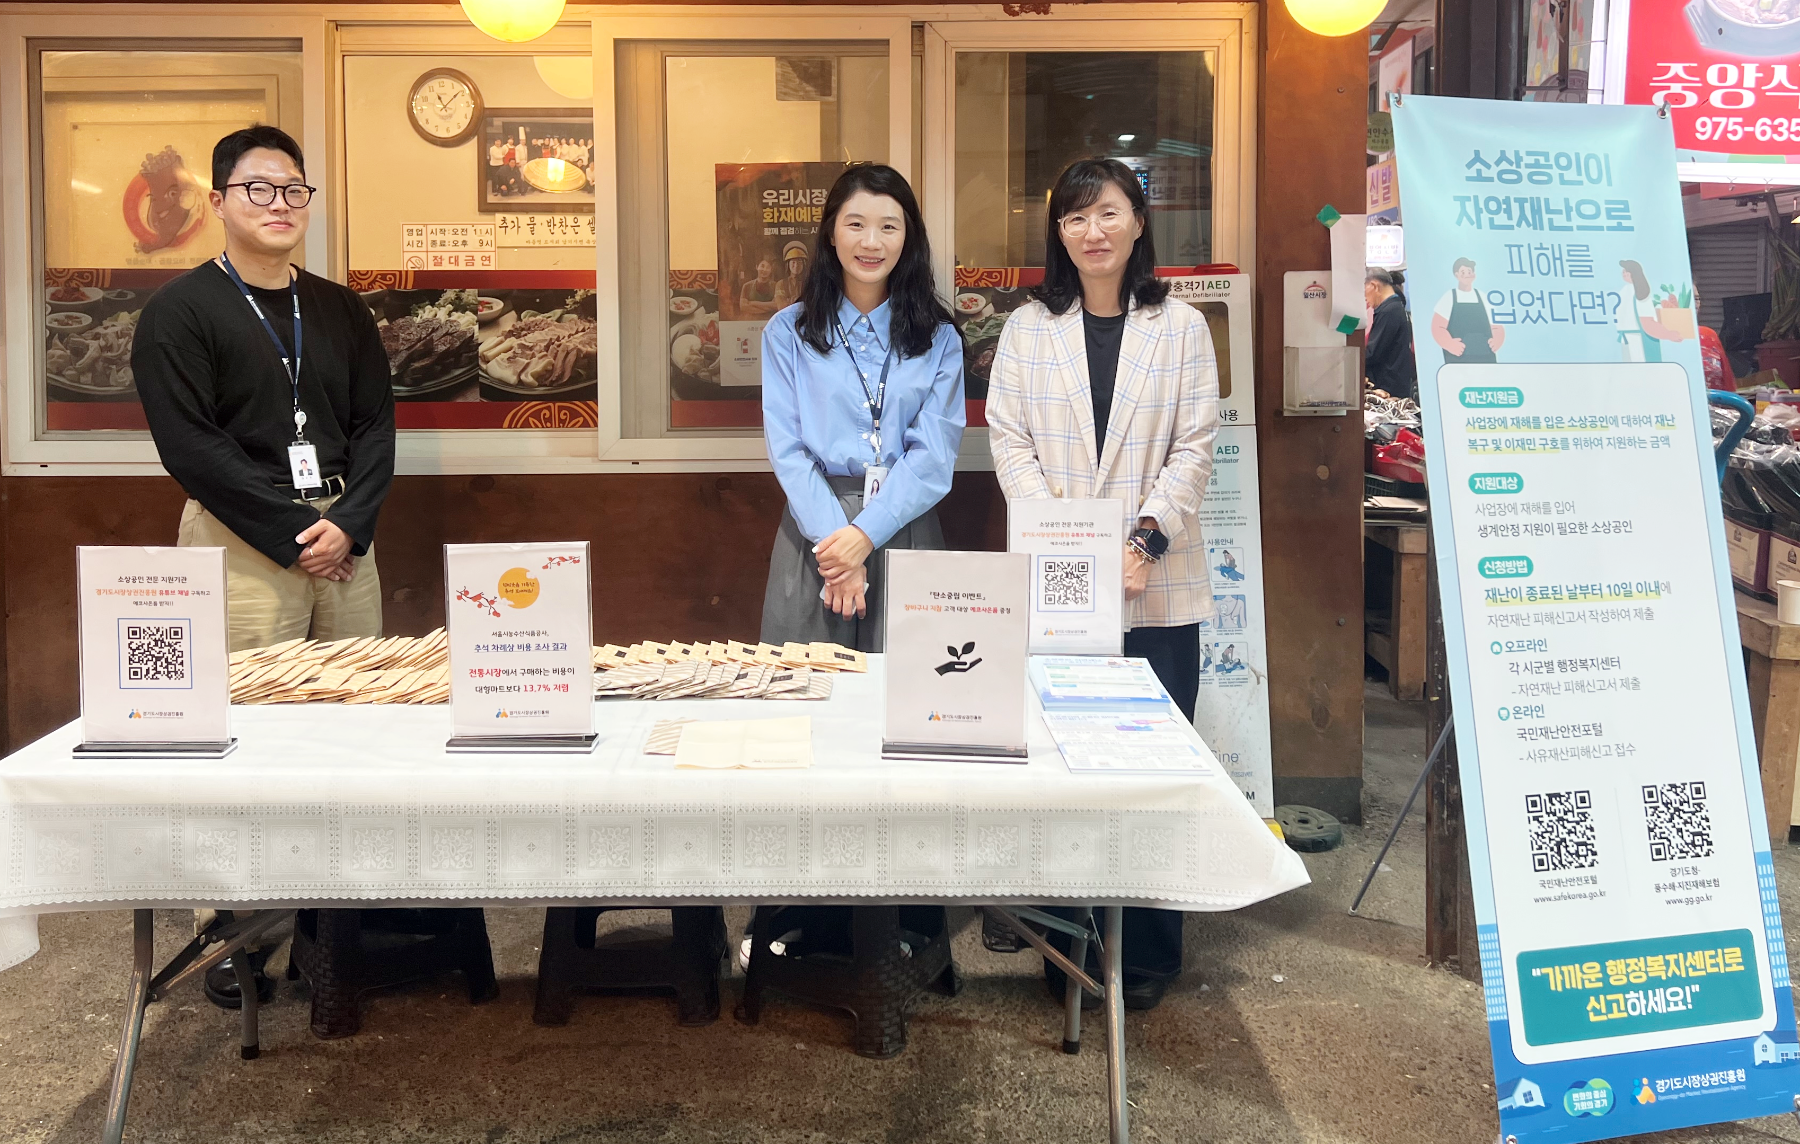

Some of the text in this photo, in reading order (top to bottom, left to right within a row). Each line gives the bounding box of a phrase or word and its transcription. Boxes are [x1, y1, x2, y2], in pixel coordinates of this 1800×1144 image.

[438, 80, 446, 88] 12
[421, 95, 429, 103] 10
[1464, 148, 1614, 188] 소상공인이
[1369, 164, 1393, 208] 신발
[762, 188, 828, 206] 우리시장
[1452, 194, 1635, 233] 자연재난으로
[406, 228, 423, 237] 영업
[498, 216, 521, 236] 추가
[779, 226, 810, 236] 점검하는
[406, 239, 423, 248] 시간
[1503, 242, 1595, 279] 피해를
[1486, 289, 1622, 326] 입었다면?
[1464, 390, 1519, 405] 재난지원금
[1465, 413, 1676, 430] 사업장에 재해를 입은 소상공인에 대하여 재난
[1216, 445, 1240, 455] AED
[1467, 434, 1671, 452] 복구 및 이재민 구호를 위하여 지원하는 금액
[1473, 476, 1518, 491] 지원대상
[1475, 500, 1576, 517] 사업장에 재해를 입어
[1478, 519, 1633, 538] 생계안정 지원이 필요한 소상공인
[1207, 537, 1234, 546] 사용안내
[1484, 559, 1528, 575] 신청방법
[118, 576, 188, 584] 소상공인 전문 지원기관
[95, 588, 157, 597] 경기도시장상권진흥원
[159, 589, 176, 597] 유튜브
[177, 589, 190, 597] 채널
[1484, 580, 1672, 603] 재난이 종료된 날부터 10일 이내에
[904, 604, 928, 613] 장바구니
[930, 604, 942, 612] 지참
[944, 605, 956, 613] 고객
[1487, 607, 1655, 628] 자연재난 피해신고서 작성하여 제출
[473, 642, 568, 653] 추석 차례상 비용 조사 결과
[1504, 637, 1548, 654] 오프라인
[468, 667, 575, 678] 전통시장에서 구매하는 비용이
[1508, 656, 1622, 676] 각 시군별 행정복지센터
[475, 683, 569, 693] 대형마트보다 13.7% 저렴
[1517, 676, 1641, 697] 자연재난 피해신고서 제출
[1512, 703, 1545, 720] 온라인
[1516, 722, 1603, 741] 국민재난안전포털
[1525, 742, 1637, 764] 사유재산피해신고 접수
[1538, 875, 1598, 888] 국민재난안전포털
[1533, 889, 1607, 905] www.safekorea.go.kr
[1664, 893, 1714, 906] www.gg.go.kr
[1606, 946, 1746, 987] 행정복지센터로
[1655, 1068, 1746, 1093] 경기도시장상권진흥원
